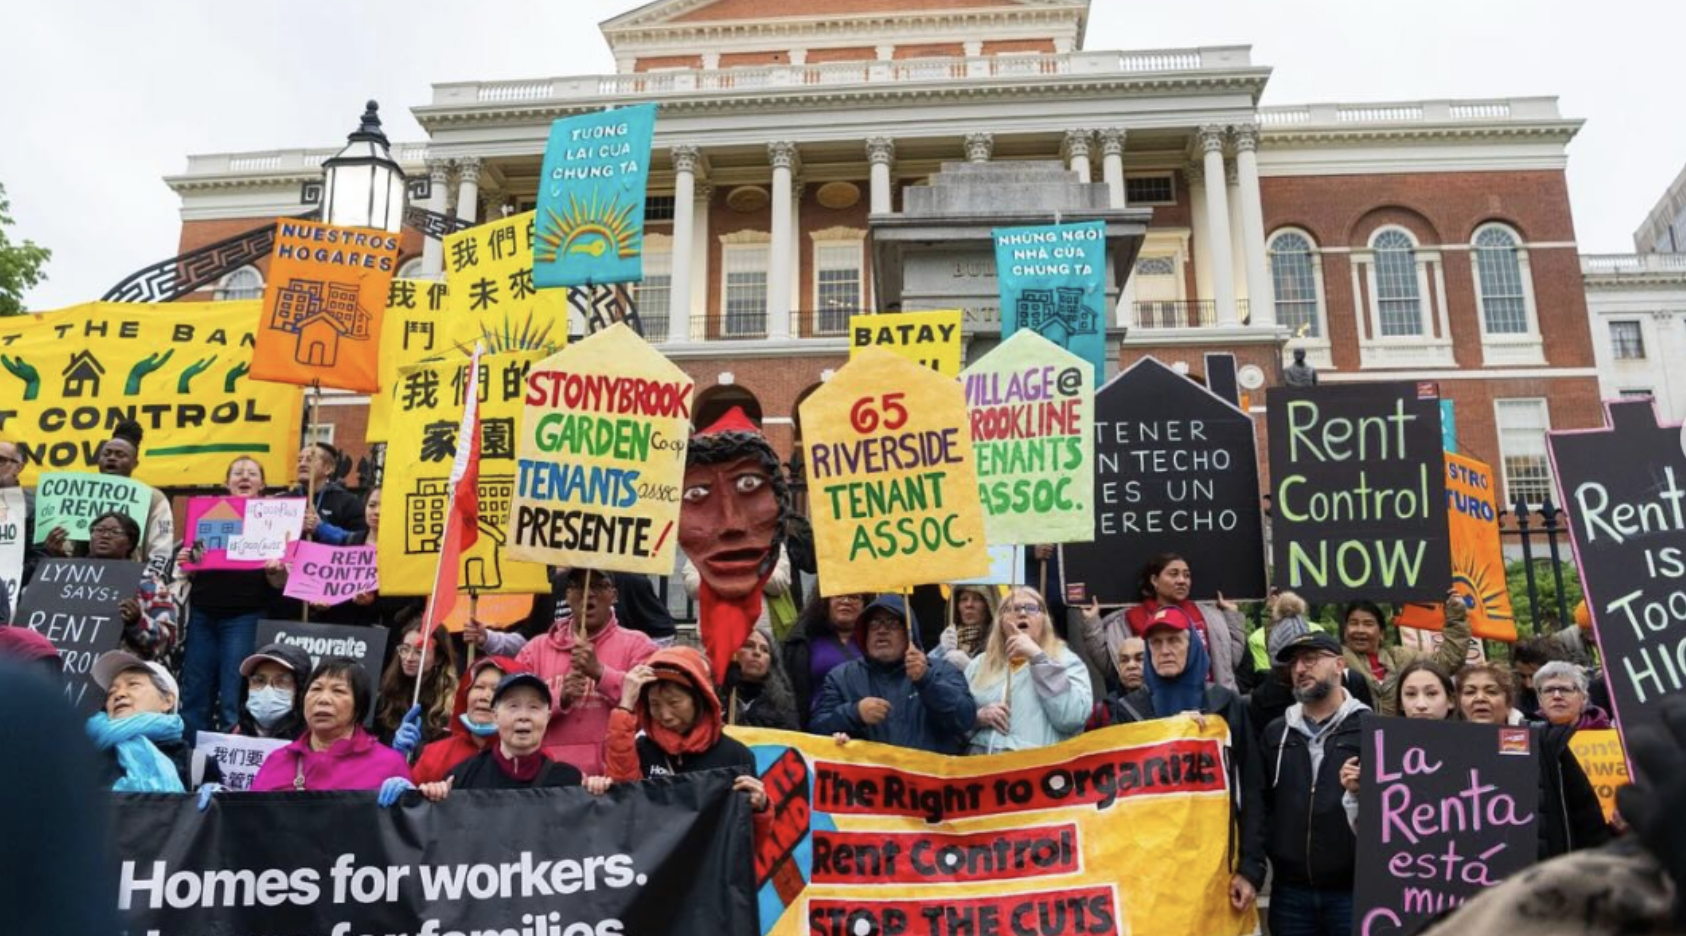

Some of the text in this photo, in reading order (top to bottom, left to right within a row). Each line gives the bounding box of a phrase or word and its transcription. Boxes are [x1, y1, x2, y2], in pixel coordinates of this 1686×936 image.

[566, 147, 593, 161] LAI
[620, 160, 638, 174] TA
[278, 244, 393, 272] HOGARES
[281, 223, 397, 251] NUESTROS
[469, 267, 536, 311] 未來
[1074, 264, 1092, 275] TA
[54, 320, 140, 339] THE
[855, 323, 956, 347] BATAY
[39, 398, 272, 433] CONTROL
[525, 370, 694, 419] STONYBROOK
[850, 392, 908, 434] 65
[420, 417, 515, 463] 家園
[535, 413, 652, 460] GARDEN
[968, 399, 1082, 442] ROOKLINE
[1094, 420, 1207, 443] TENER
[1287, 398, 1418, 462] Rent
[811, 428, 963, 479] RIVERSIDE
[1098, 448, 1230, 474] N TECHO
[42, 479, 140, 504] CONTROL
[518, 459, 640, 508] TENANTS
[824, 471, 946, 519] TENANT
[978, 476, 1083, 515] ASSOC.
[1102, 479, 1214, 503] ES UN
[1279, 463, 1429, 522] Control
[1574, 465, 1686, 543] Rent
[515, 505, 674, 557] PRESENTE!
[849, 514, 973, 561] ASSOC.
[1101, 509, 1237, 534] ERECHO
[40, 563, 105, 583] LYNN
[330, 551, 377, 567] REN
[1289, 539, 1427, 588] NOW
[60, 584, 119, 601] SAYS:
[27, 611, 111, 644] RENT
[1605, 589, 1686, 641] Too
[213, 746, 265, 767] 我们要
[1374, 729, 1443, 784] La
[817, 752, 1216, 823] The Right to Organize
[1381, 768, 1535, 844] Renta
[812, 830, 1071, 876] Rent Control
[1388, 838, 1507, 886] está
[118, 851, 648, 909] Homes for workers.
[1404, 886, 1465, 914] mu
[809, 894, 1114, 936] STOP THE CUTS
